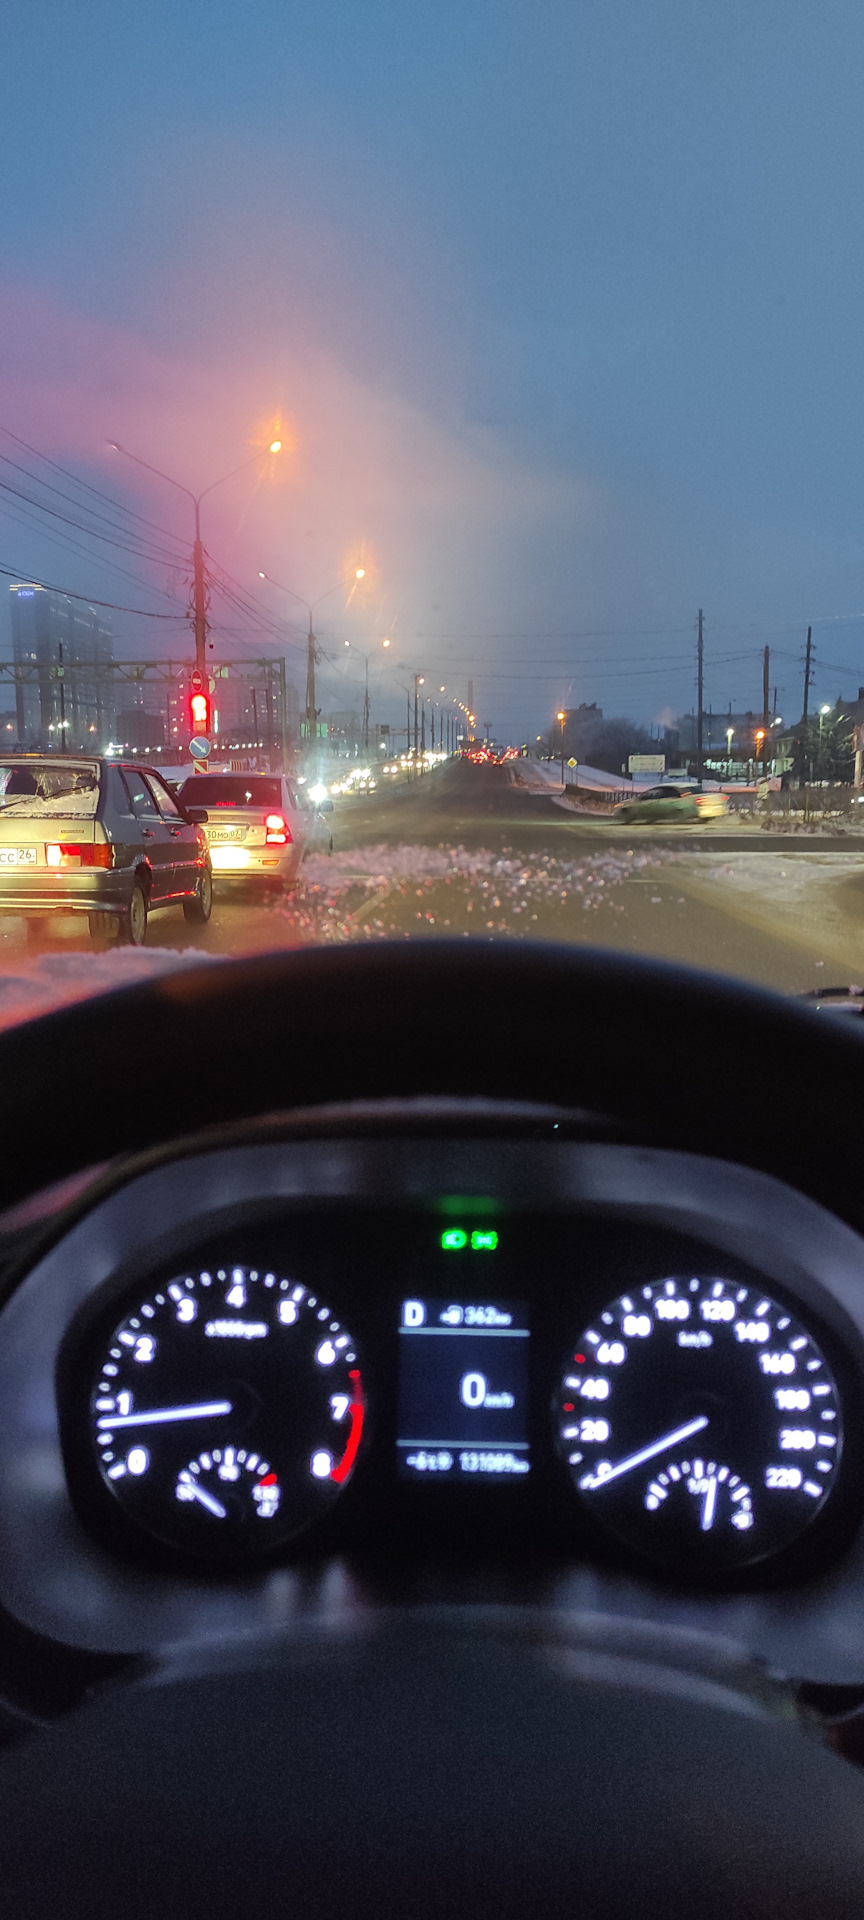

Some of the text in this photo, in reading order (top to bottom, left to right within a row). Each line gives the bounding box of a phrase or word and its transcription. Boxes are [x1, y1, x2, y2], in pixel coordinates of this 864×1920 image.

[19, 849, 32, 859] 26
[225, 1284, 246, 1308] 4
[176, 1296, 197, 1324] 3
[277, 1298, 298, 1326] 5
[403, 1299, 425, 1327] D
[654, 1299, 690, 1320] 100
[700, 1299, 736, 1321] 120
[622, 1314, 652, 1337] 80
[733, 1321, 770, 1343] 140
[134, 1335, 156, 1362] 2
[315, 1340, 337, 1366] 6
[595, 1342, 626, 1365] 60
[759, 1353, 796, 1375] 160
[461, 1371, 487, 1408] 0
[580, 1378, 610, 1401] 40
[775, 1390, 810, 1410] 180
[116, 1390, 132, 1416] 1
[329, 1394, 350, 1421] 7
[580, 1417, 610, 1442] 20
[779, 1430, 817, 1450] 200
[126, 1446, 149, 1476] 0
[310, 1448, 332, 1478] 8
[765, 1467, 802, 1489] 220
